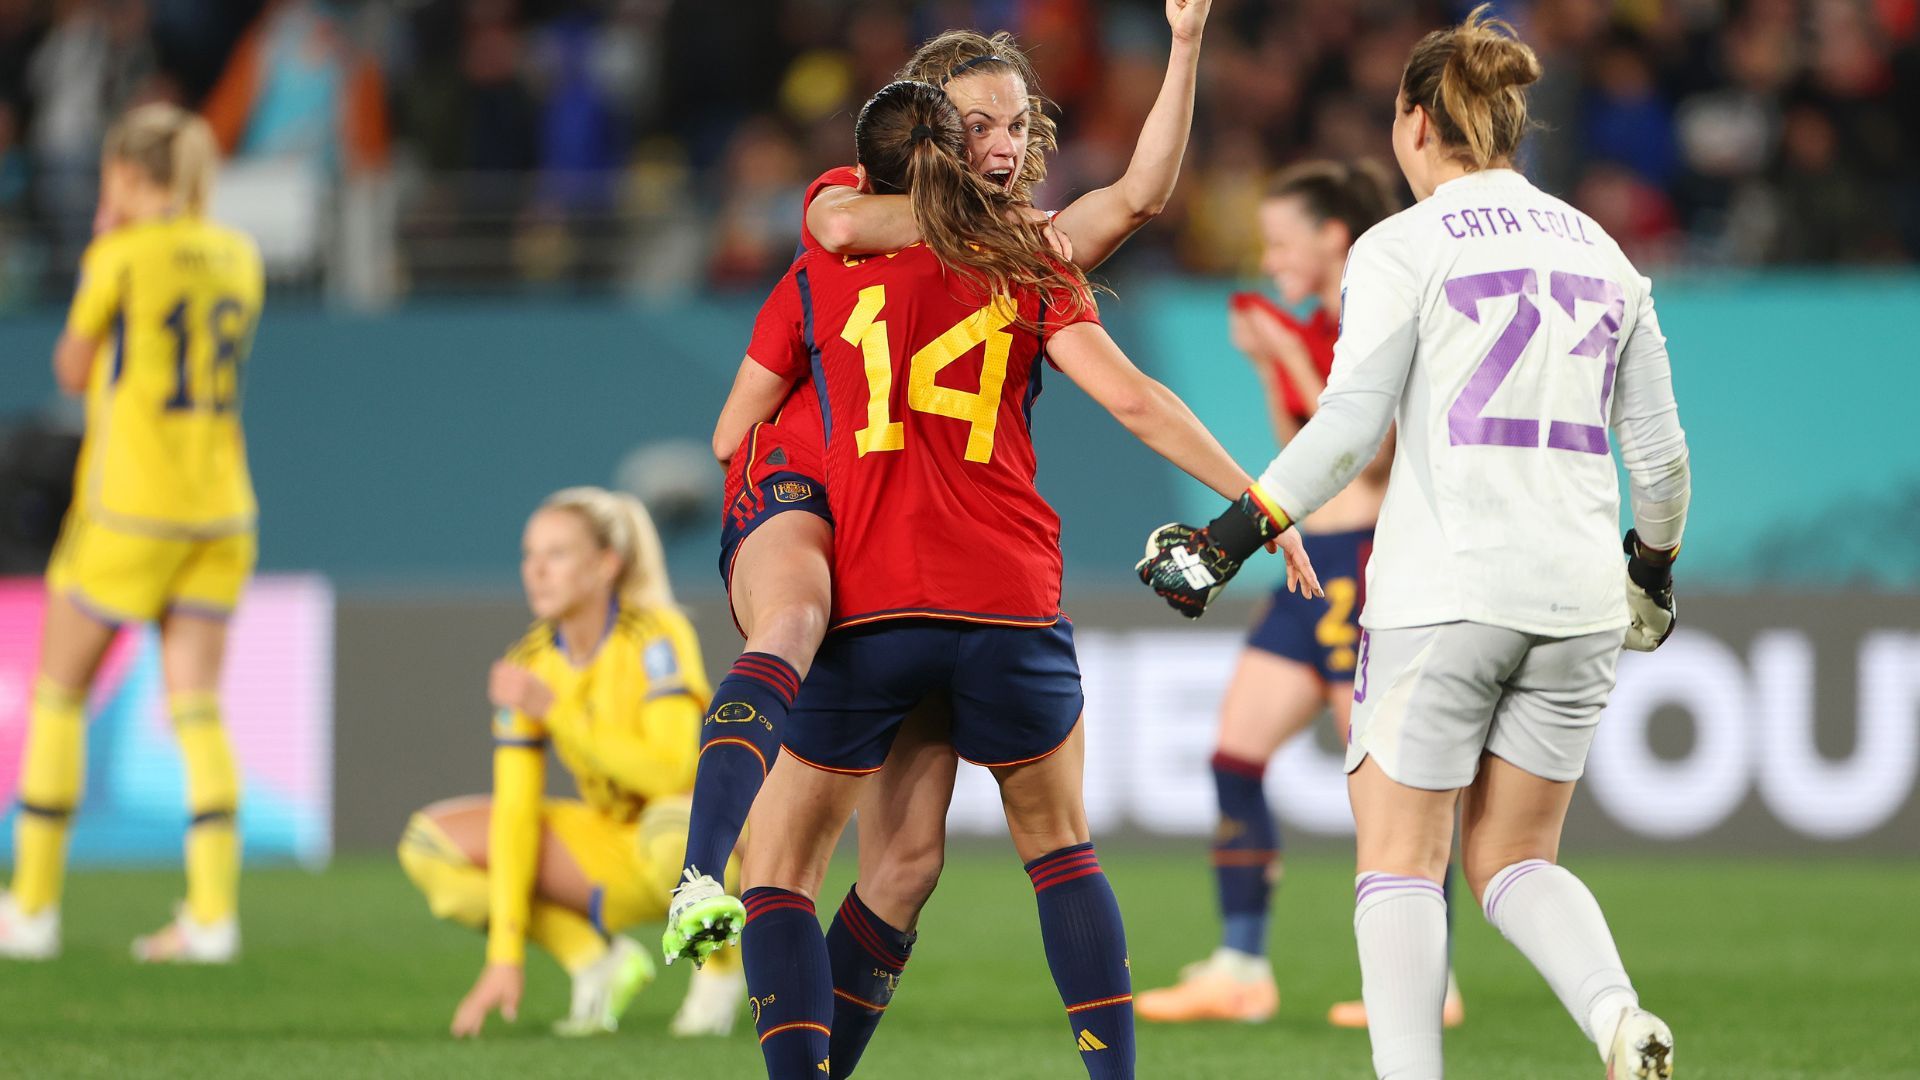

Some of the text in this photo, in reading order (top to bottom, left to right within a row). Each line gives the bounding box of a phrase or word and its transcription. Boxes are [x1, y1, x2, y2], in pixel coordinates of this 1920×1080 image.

[1442, 207, 1594, 246] CATA COLL
[840, 284, 1018, 465] 14
[1444, 268, 1625, 456] 23
